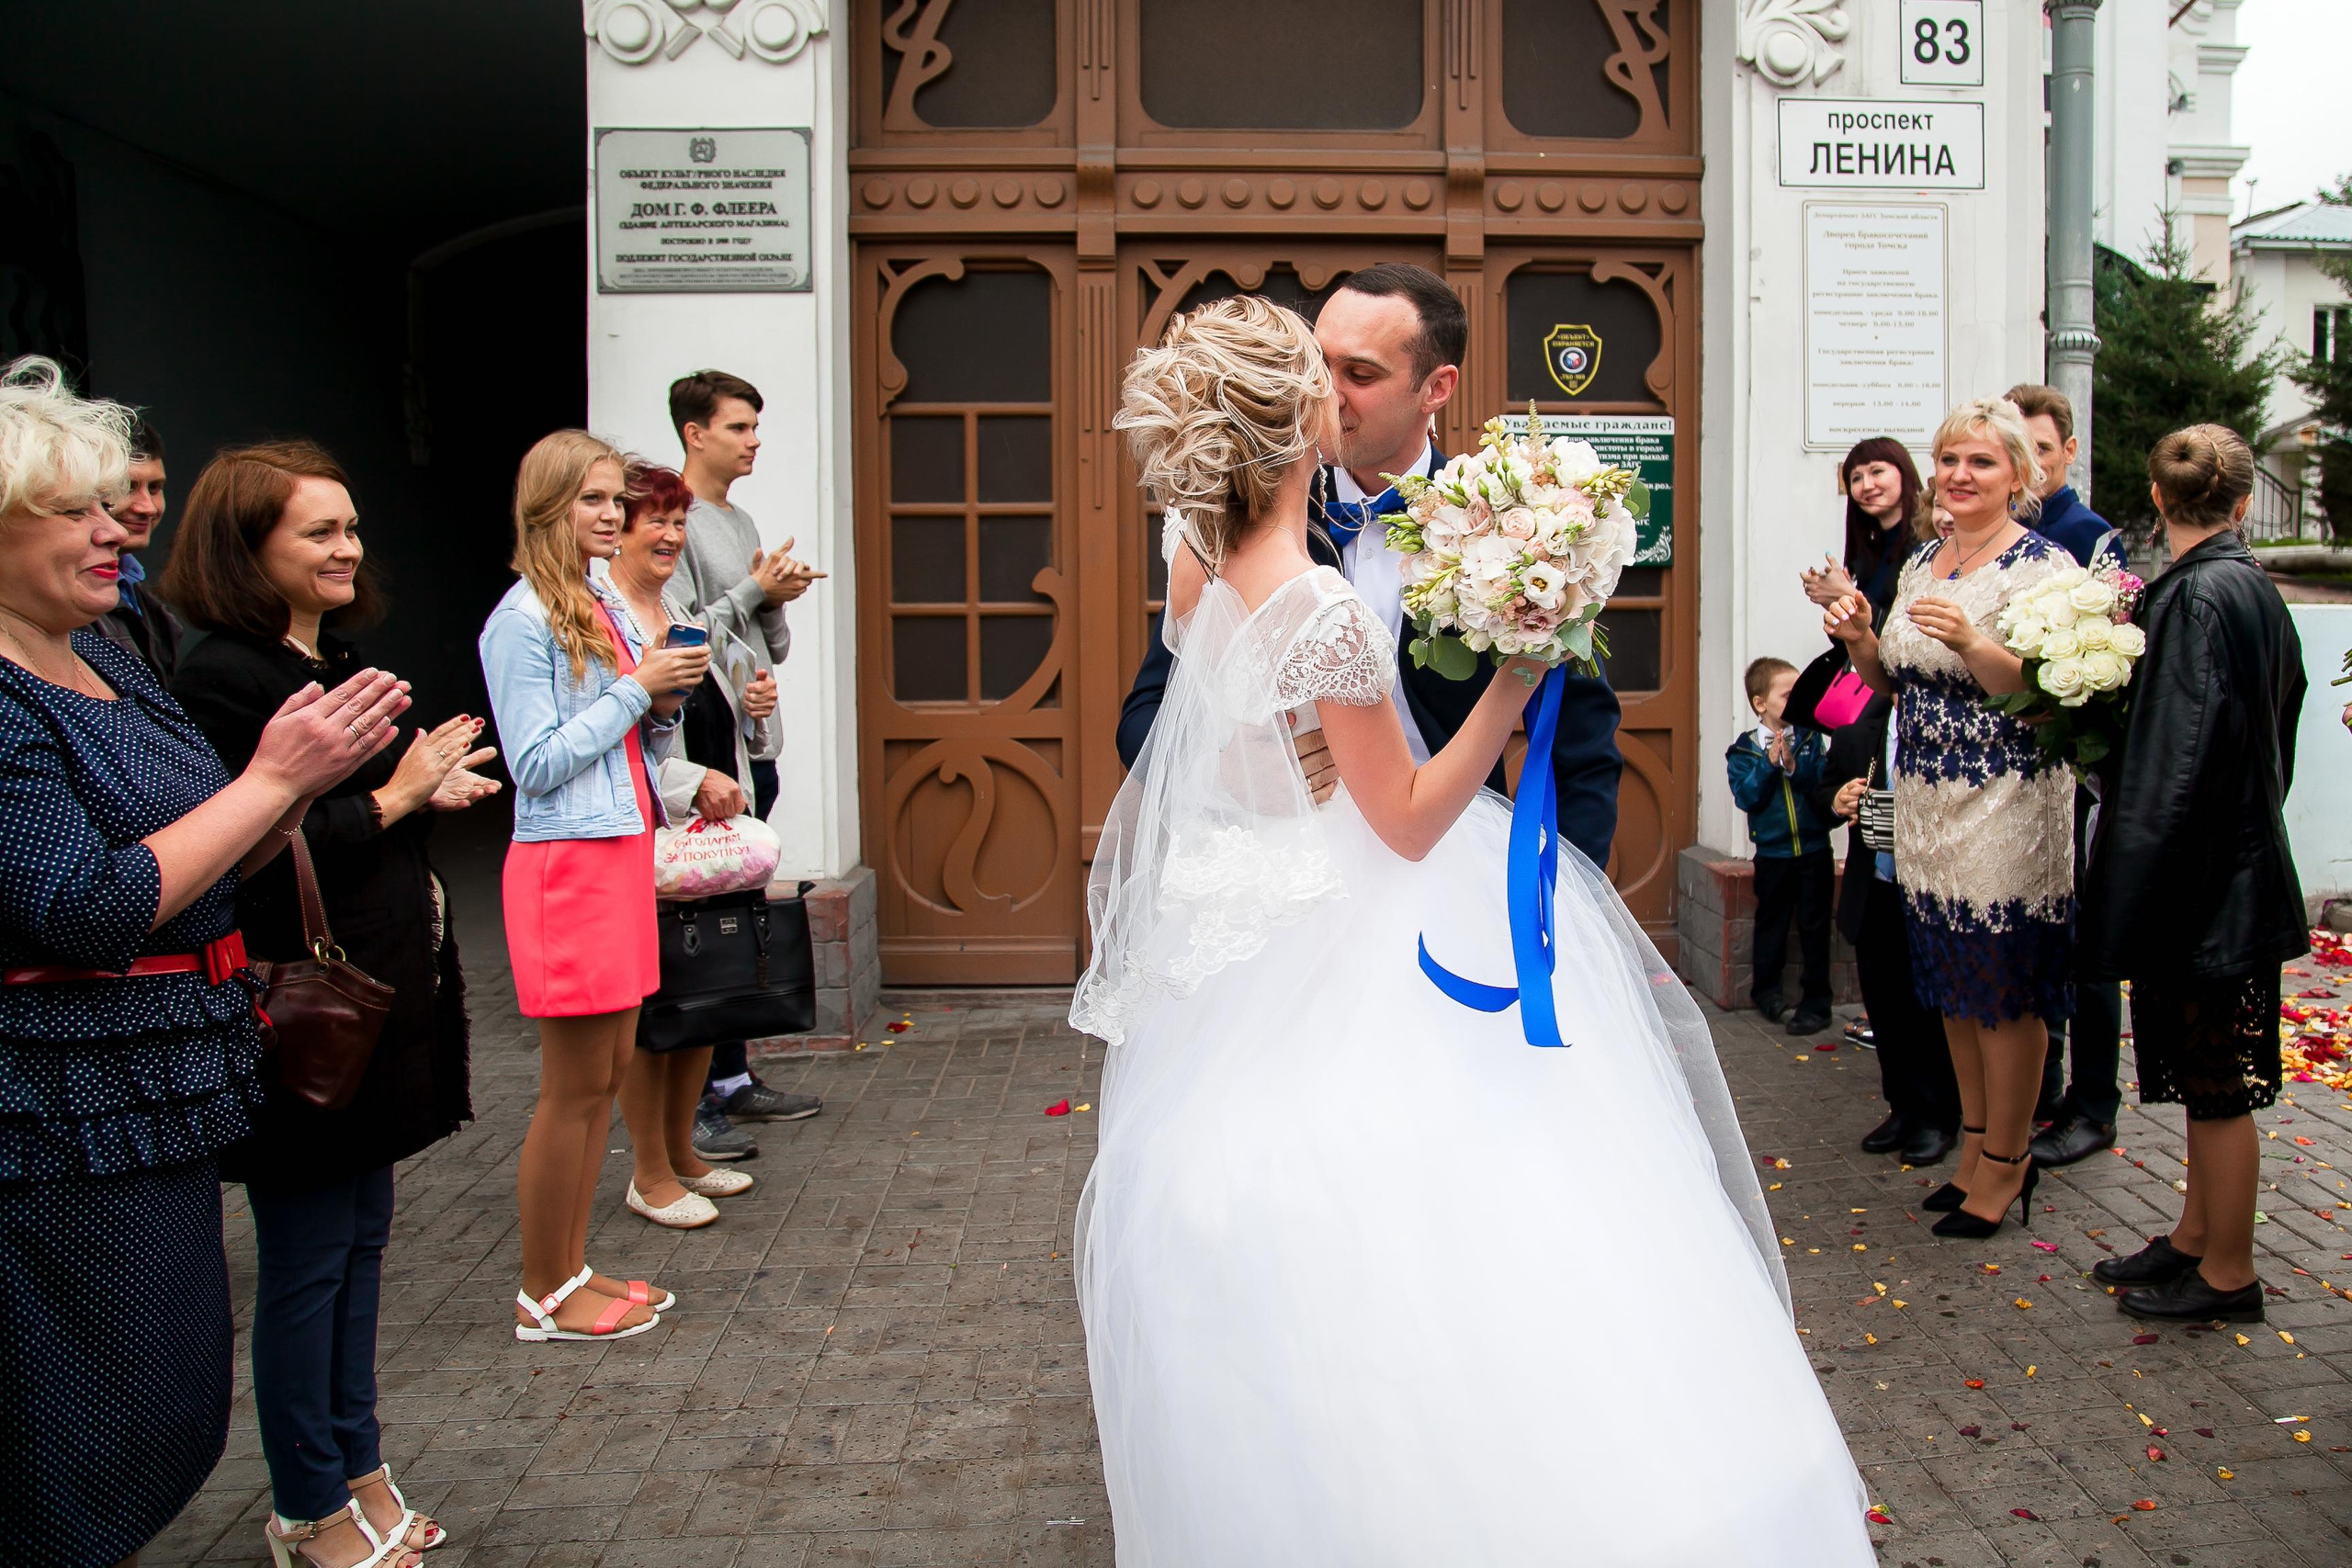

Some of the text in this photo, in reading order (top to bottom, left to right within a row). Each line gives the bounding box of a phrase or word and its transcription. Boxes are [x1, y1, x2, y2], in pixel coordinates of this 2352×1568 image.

[1914, 18, 1971, 65] 83
[1828, 113, 1934, 135] проспект
[1809, 142, 1956, 176] ЛЕНИНА
[631, 202, 777, 218] ДОМ Г. Ф. ФЛЕЕРА
[1878, 242, 1908, 250] Томска
[1503, 418, 1672, 432] Увааемые граждане!
[1635, 435, 1660, 446] брака
[1635, 446, 1664, 454] городе
[1621, 460, 1642, 469] ЗАГС
[1623, 454, 1638, 462] при
[684, 845, 751, 862] ПОКУПКУ!
